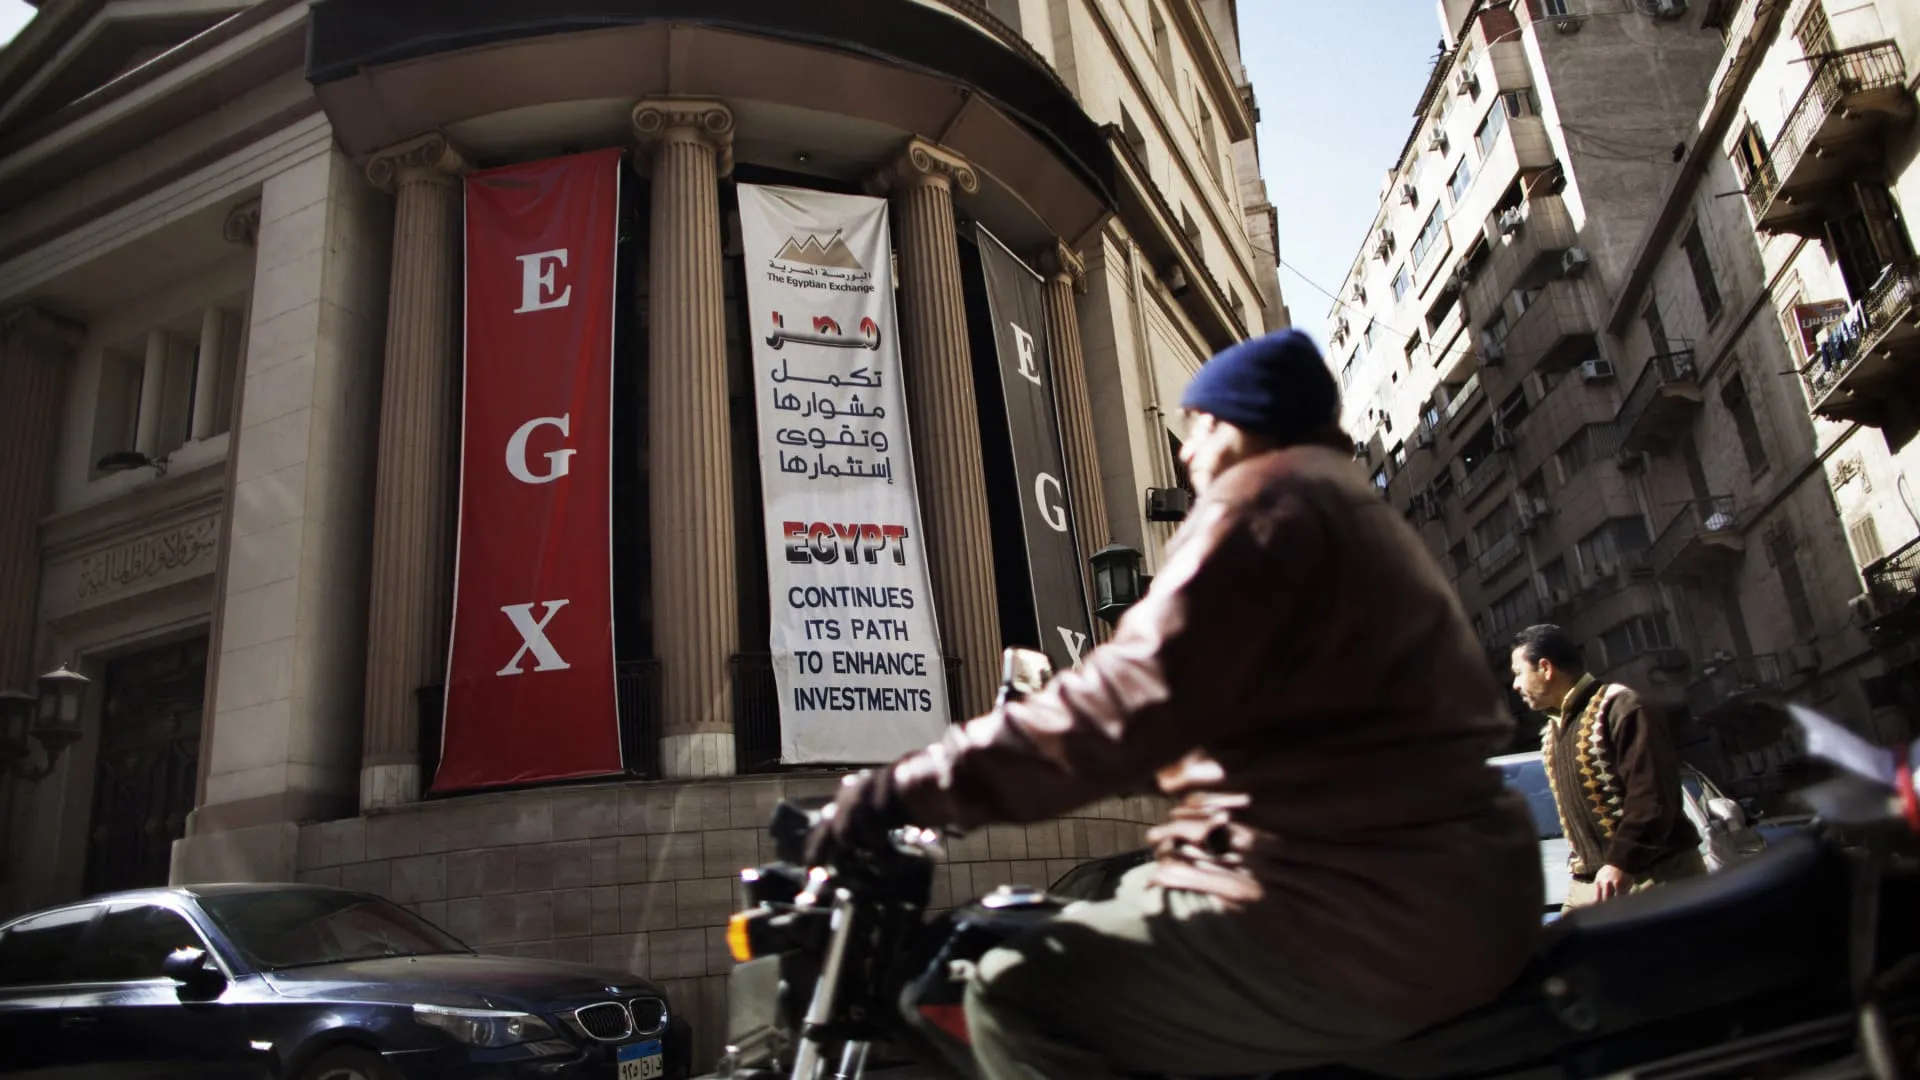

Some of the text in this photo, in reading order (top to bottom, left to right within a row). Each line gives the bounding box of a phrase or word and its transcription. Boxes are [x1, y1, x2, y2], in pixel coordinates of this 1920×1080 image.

[766, 272, 876, 294] The Egyptian Exchange
[768, 259, 872, 283] البورصة المصرية
[765, 310, 882, 351] مصر
[770, 358, 883, 388] تكمل
[773, 387, 886, 420] مشوارها
[776, 424, 889, 452] وتقوى
[779, 450, 893, 485] إستثمارها
[782, 520, 909, 566] EGYPT
[787, 586, 915, 610] CONTINUES
[804, 618, 910, 642] ITS PATH
[793, 650, 928, 677] TO ENHANCE
[793, 686, 933, 713] INVESTMENTS
